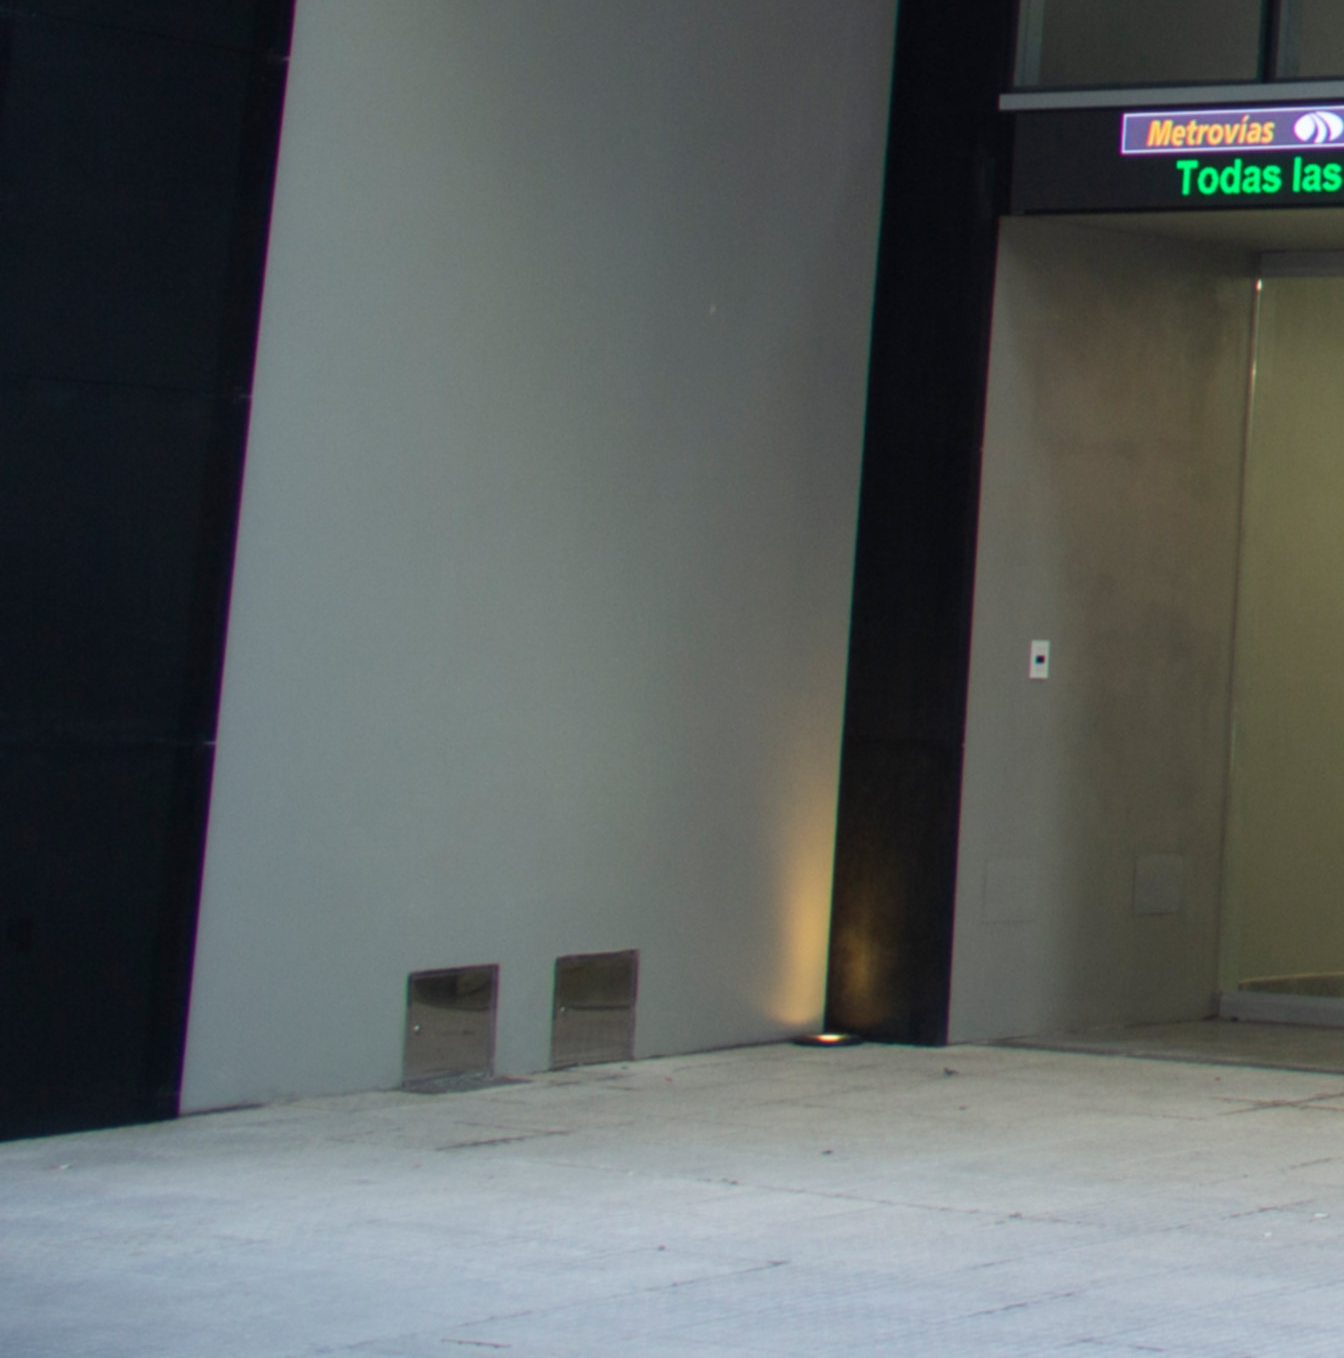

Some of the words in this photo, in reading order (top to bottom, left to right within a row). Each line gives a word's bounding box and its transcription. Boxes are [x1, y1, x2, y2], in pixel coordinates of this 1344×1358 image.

[1146, 115, 1276, 147] Metrovías
[1176, 158, 1282, 196] Todas
[1292, 156, 1343, 192] las
